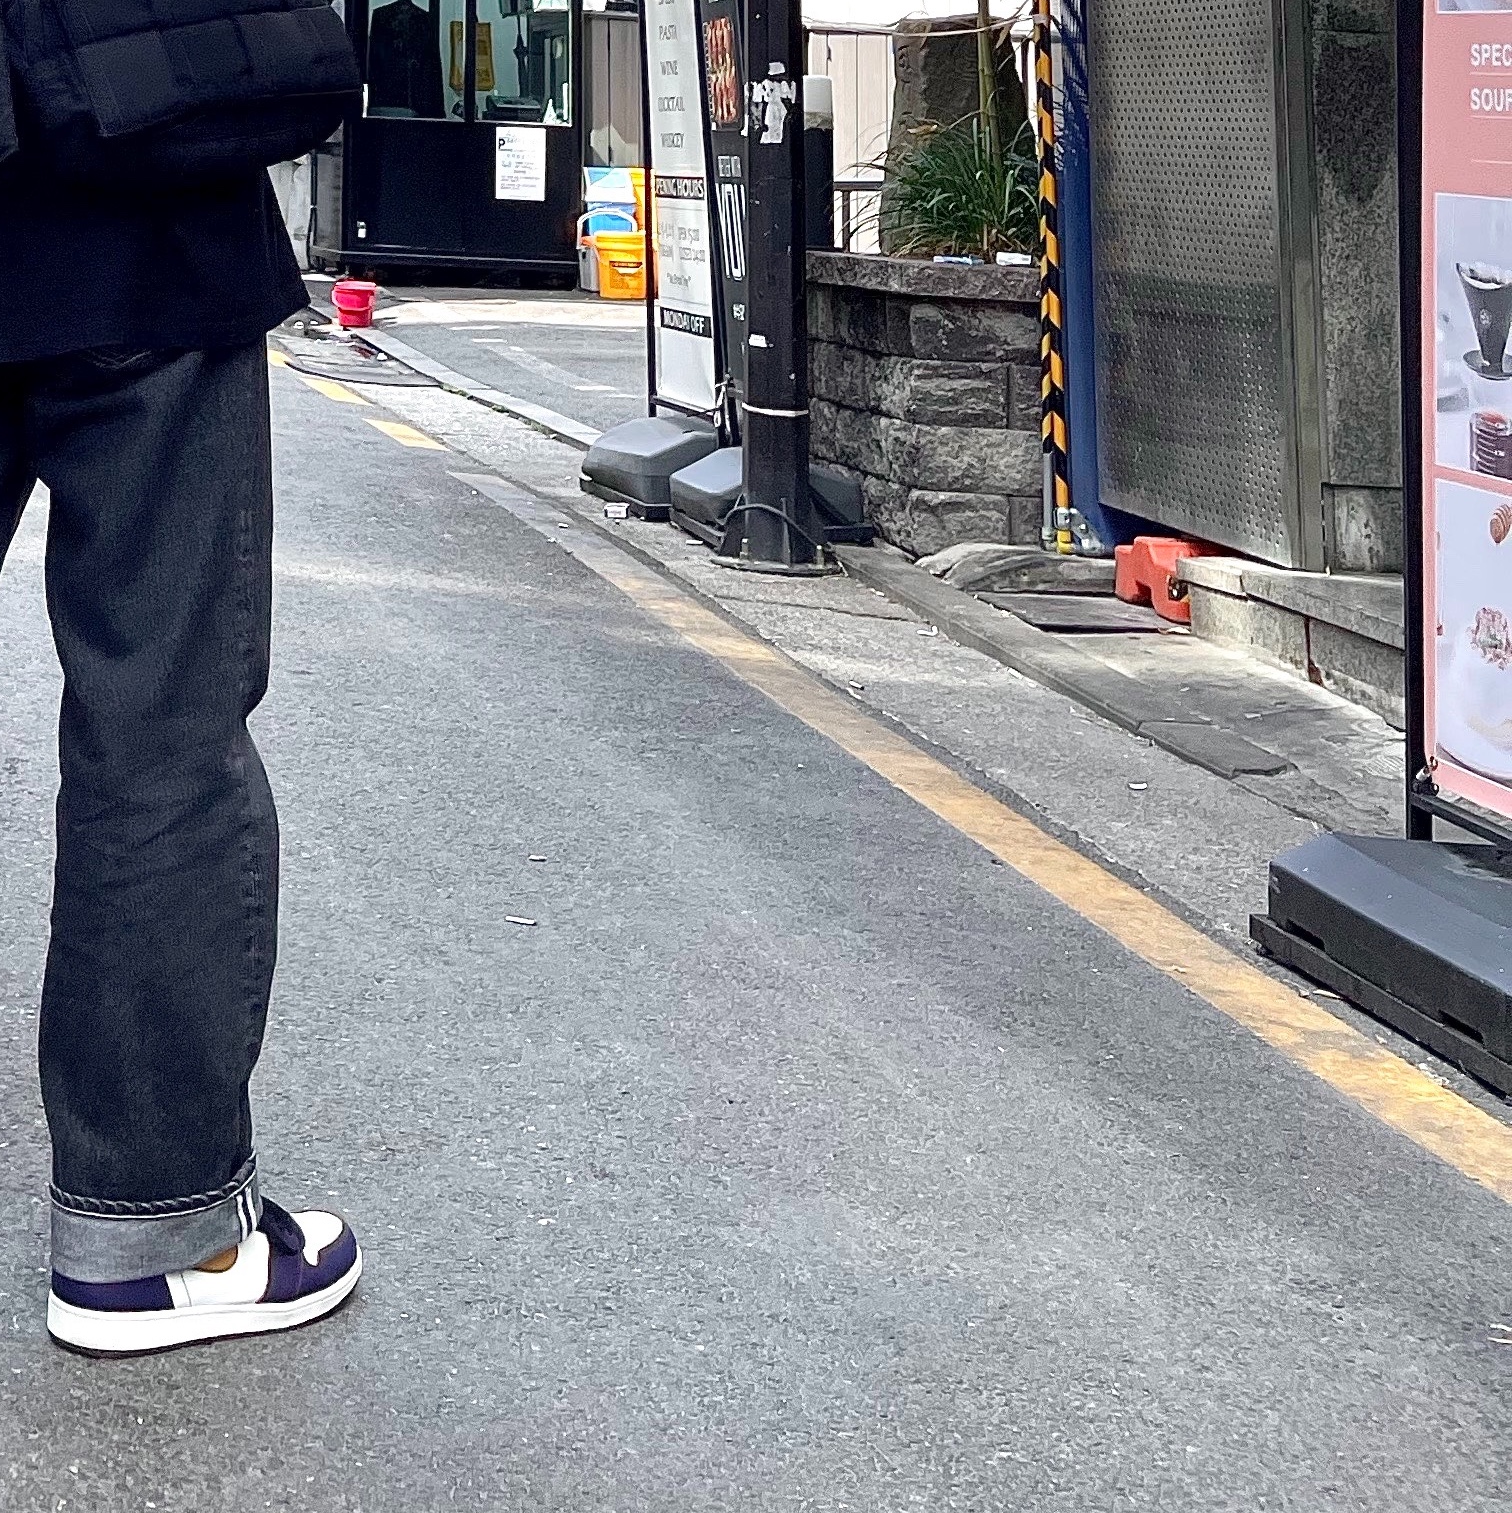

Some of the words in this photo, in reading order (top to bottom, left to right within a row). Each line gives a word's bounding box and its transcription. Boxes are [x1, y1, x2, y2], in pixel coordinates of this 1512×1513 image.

[659, 60, 679, 76] WINE
[676, 178, 704, 198] HOURS
[690, 316, 705, 334] OFF
